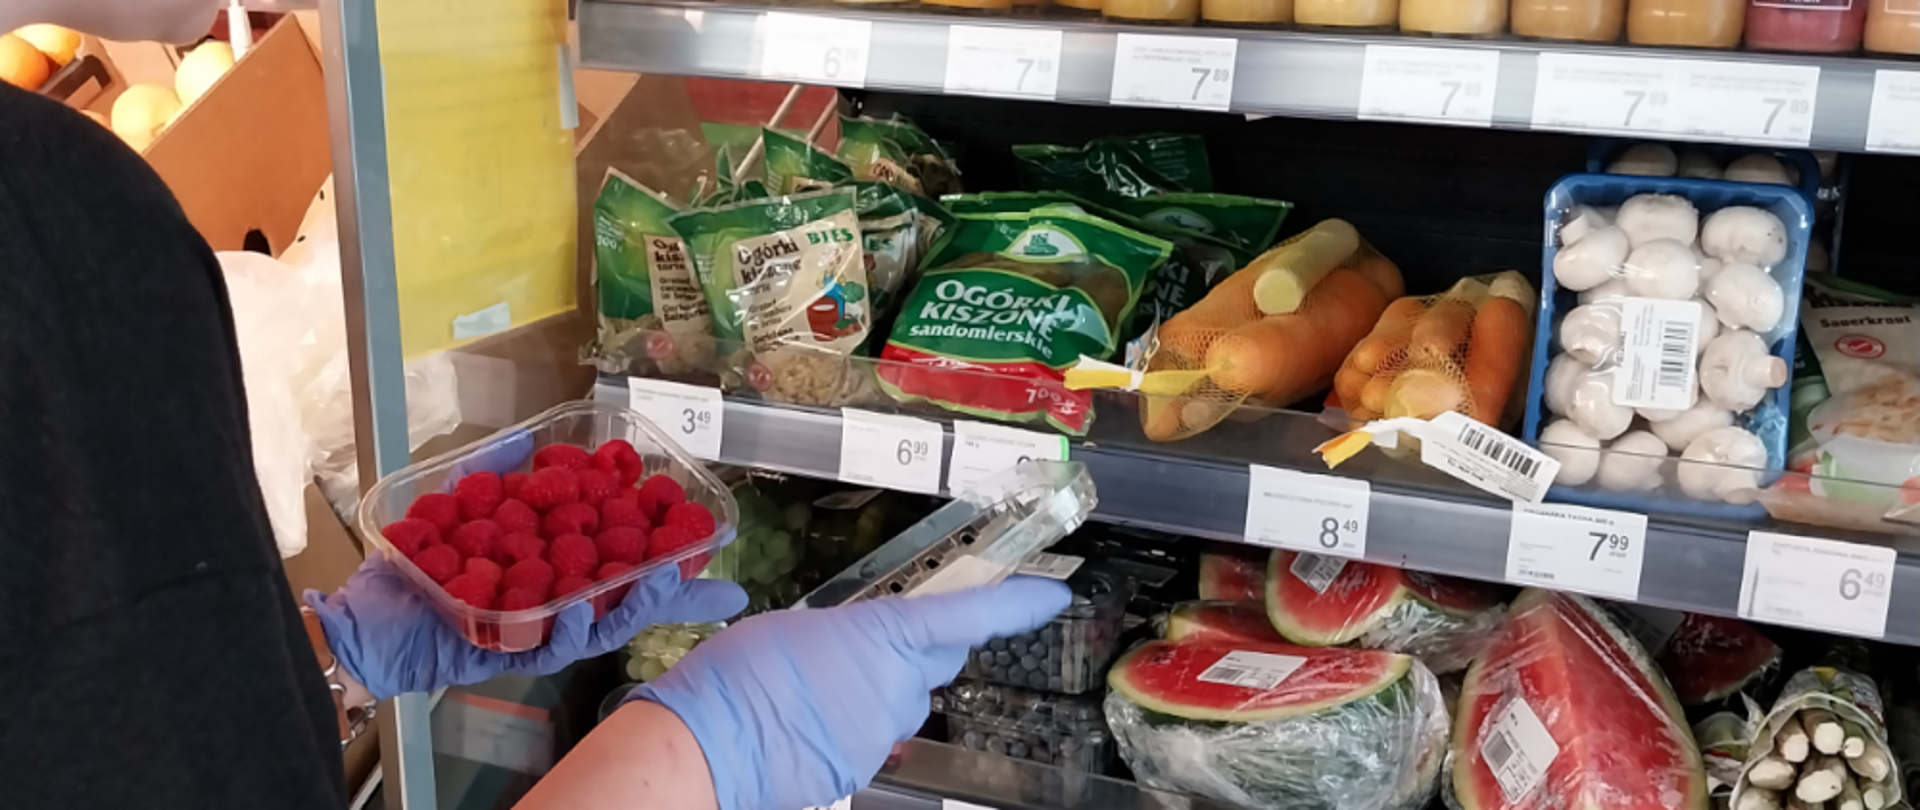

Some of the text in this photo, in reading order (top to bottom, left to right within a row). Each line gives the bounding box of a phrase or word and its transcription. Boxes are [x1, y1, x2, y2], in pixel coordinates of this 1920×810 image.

[824, 47, 841, 78] 6
[1016, 59, 1034, 91] 7
[1191, 67, 1229, 100] 7 89
[1440, 81, 1462, 116] 7
[1623, 90, 1668, 126] 7 89
[1763, 98, 1809, 134] 7 89
[738, 238, 799, 266] Ogórki
[807, 228, 854, 245] BIES
[935, 280, 1071, 316] OGÓRKI
[920, 301, 1057, 342] KISZONE
[1820, 315, 1912, 328] Sauerkraut
[908, 324, 1053, 360] sandomierskie
[682, 408, 711, 434] 3 49
[897, 439, 928, 466] 6 99
[1319, 516, 1359, 548] 8 49
[1589, 531, 1630, 561] 7 99
[1838, 568, 1886, 601] 6 49
